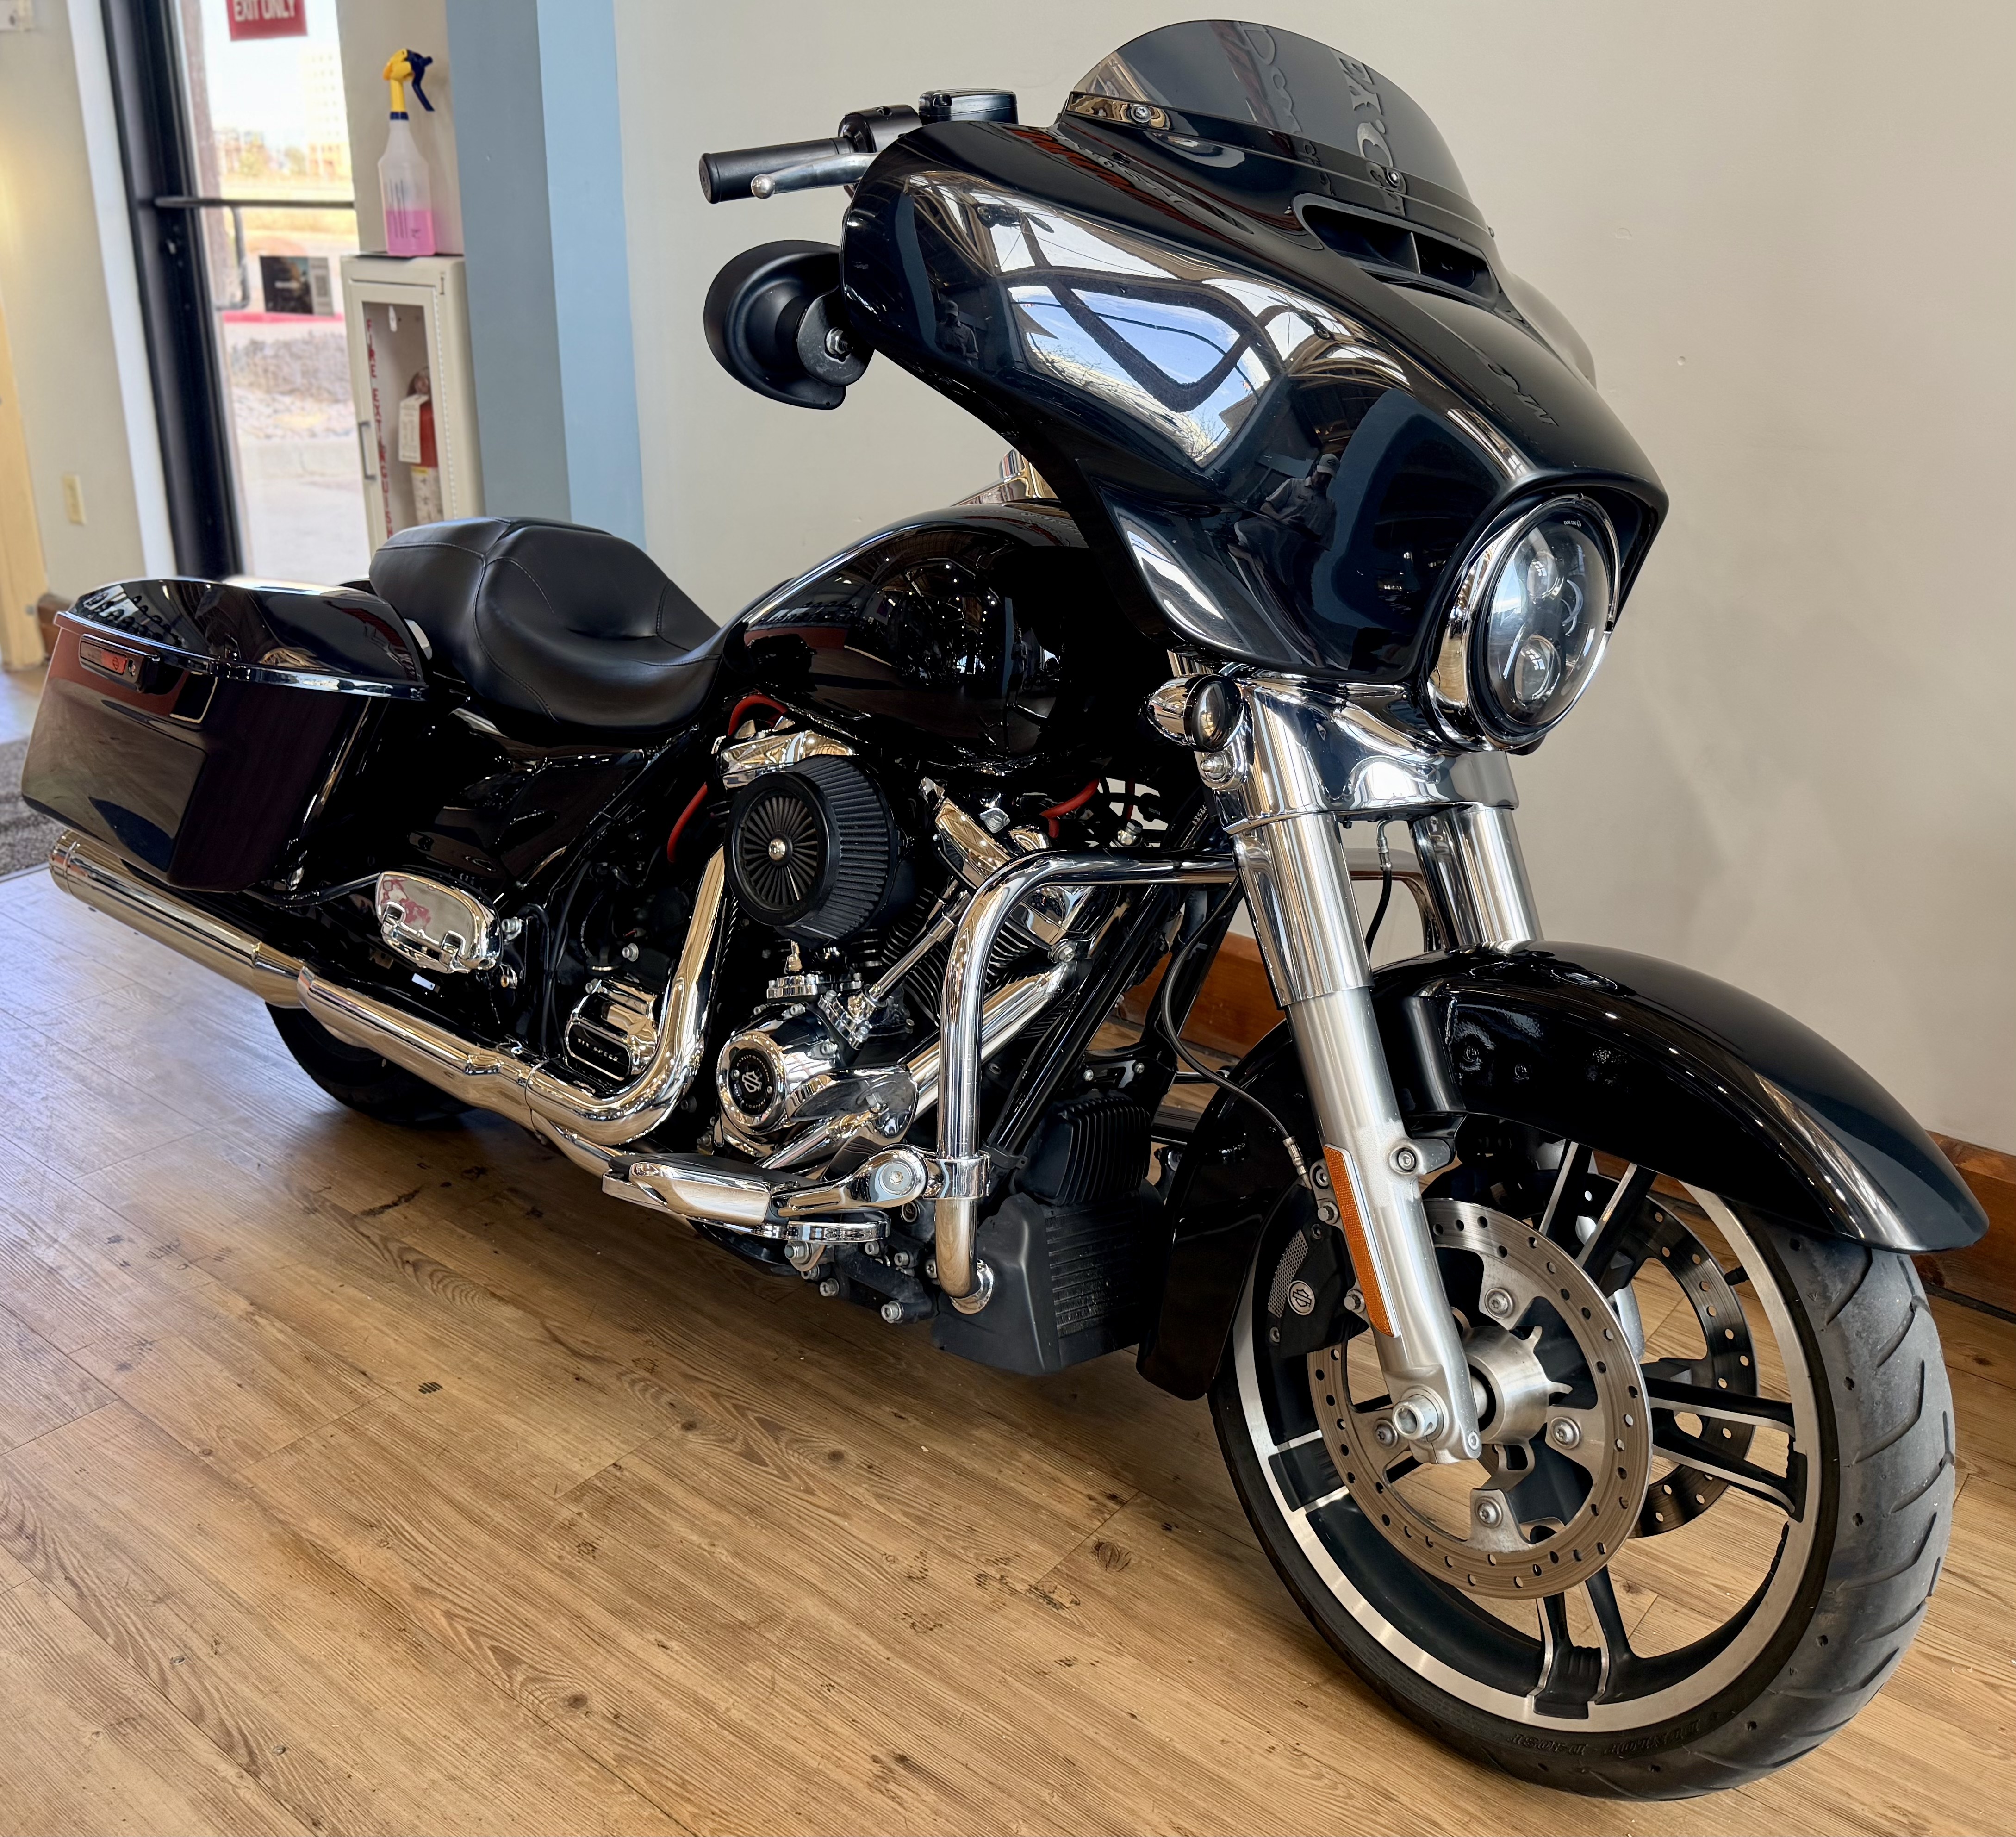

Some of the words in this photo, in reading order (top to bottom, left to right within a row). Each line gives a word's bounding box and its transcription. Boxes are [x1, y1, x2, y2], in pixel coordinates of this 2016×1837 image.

[234, 0, 260, 22] EXIT
[260, 0, 296, 20] ONLY
[366, 318, 377, 379] FIRE
[577, 1038, 589, 1048] SIX
[593, 1046, 618, 1062] SPEED
[745, 1098, 766, 1109] COMPANY
